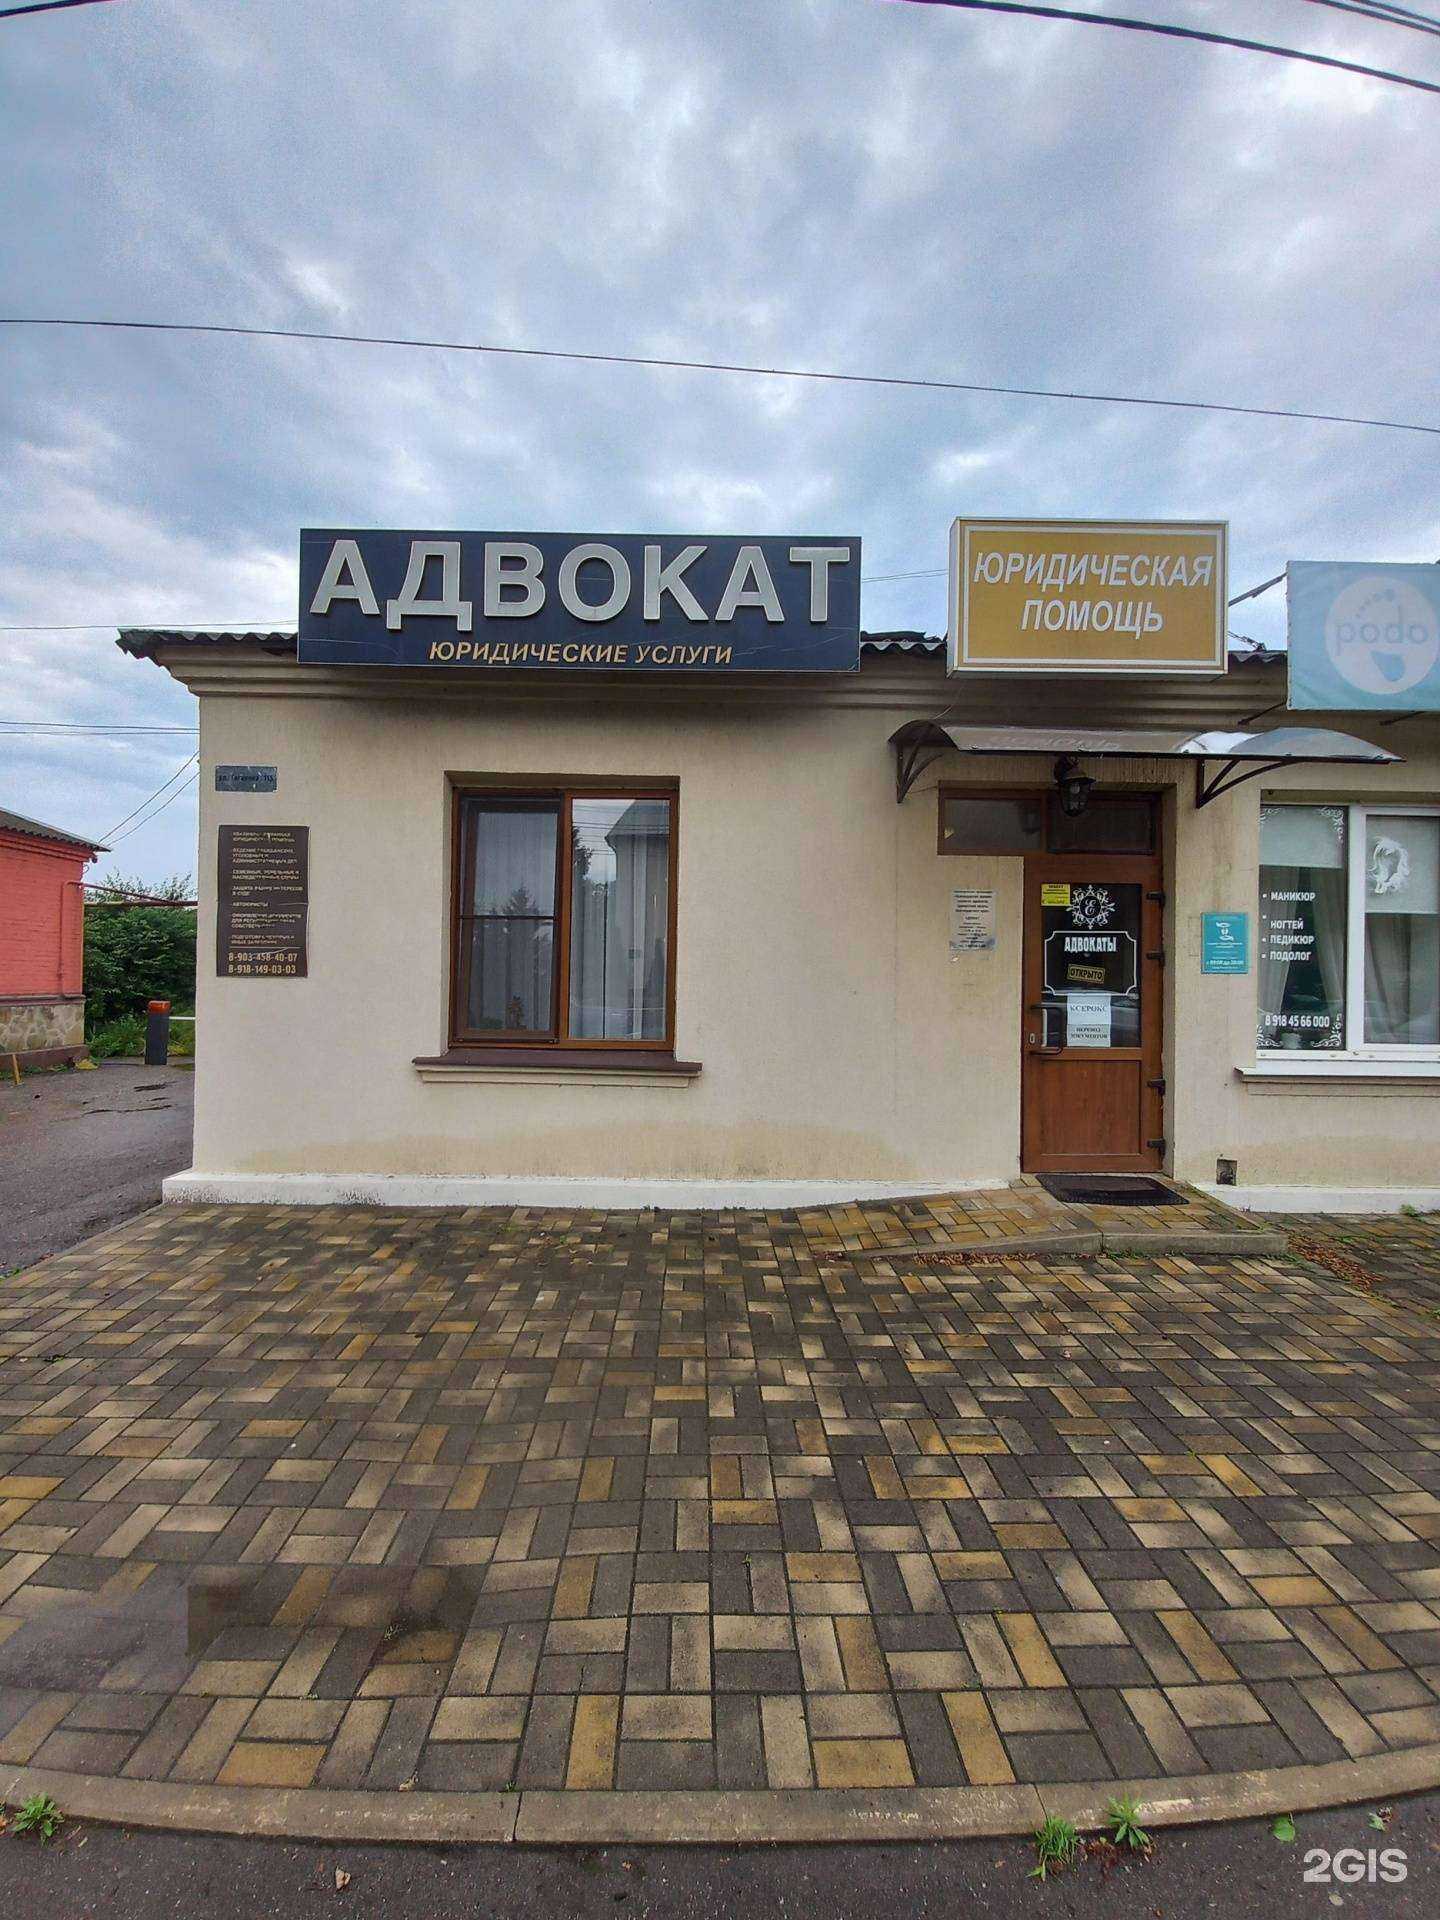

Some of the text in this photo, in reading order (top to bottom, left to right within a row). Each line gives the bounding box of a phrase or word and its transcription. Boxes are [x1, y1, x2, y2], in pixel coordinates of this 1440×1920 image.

[972, 552, 1214, 592] ЮРИДИЧЕСКАЯ
[309, 539, 851, 632] АДВОКАТ
[1021, 599, 1165, 640] ПОМОЩЬ
[1336, 604, 1428, 657] podo
[428, 641, 733, 665] ЮРИДИЧЕСКИЕ УСЛУГИ
[1270, 891, 1316, 901] МАНИКЮР
[1270, 917, 1304, 930] НОГТЕЙ
[1064, 936, 1117, 953] АДВОКАТЫ
[1270, 934, 1315, 945] ПЕДИКЮР
[227, 952, 298, 962] 8-903-458-40-07
[1269, 950, 1312, 962] ПОДОЛОГ
[227, 964, 297, 974] 8-918-149-03-03
[1070, 968, 1104, 980] ОТКРЫТО
[1264, 1014, 1330, 1028] 8 918 45 66 000
